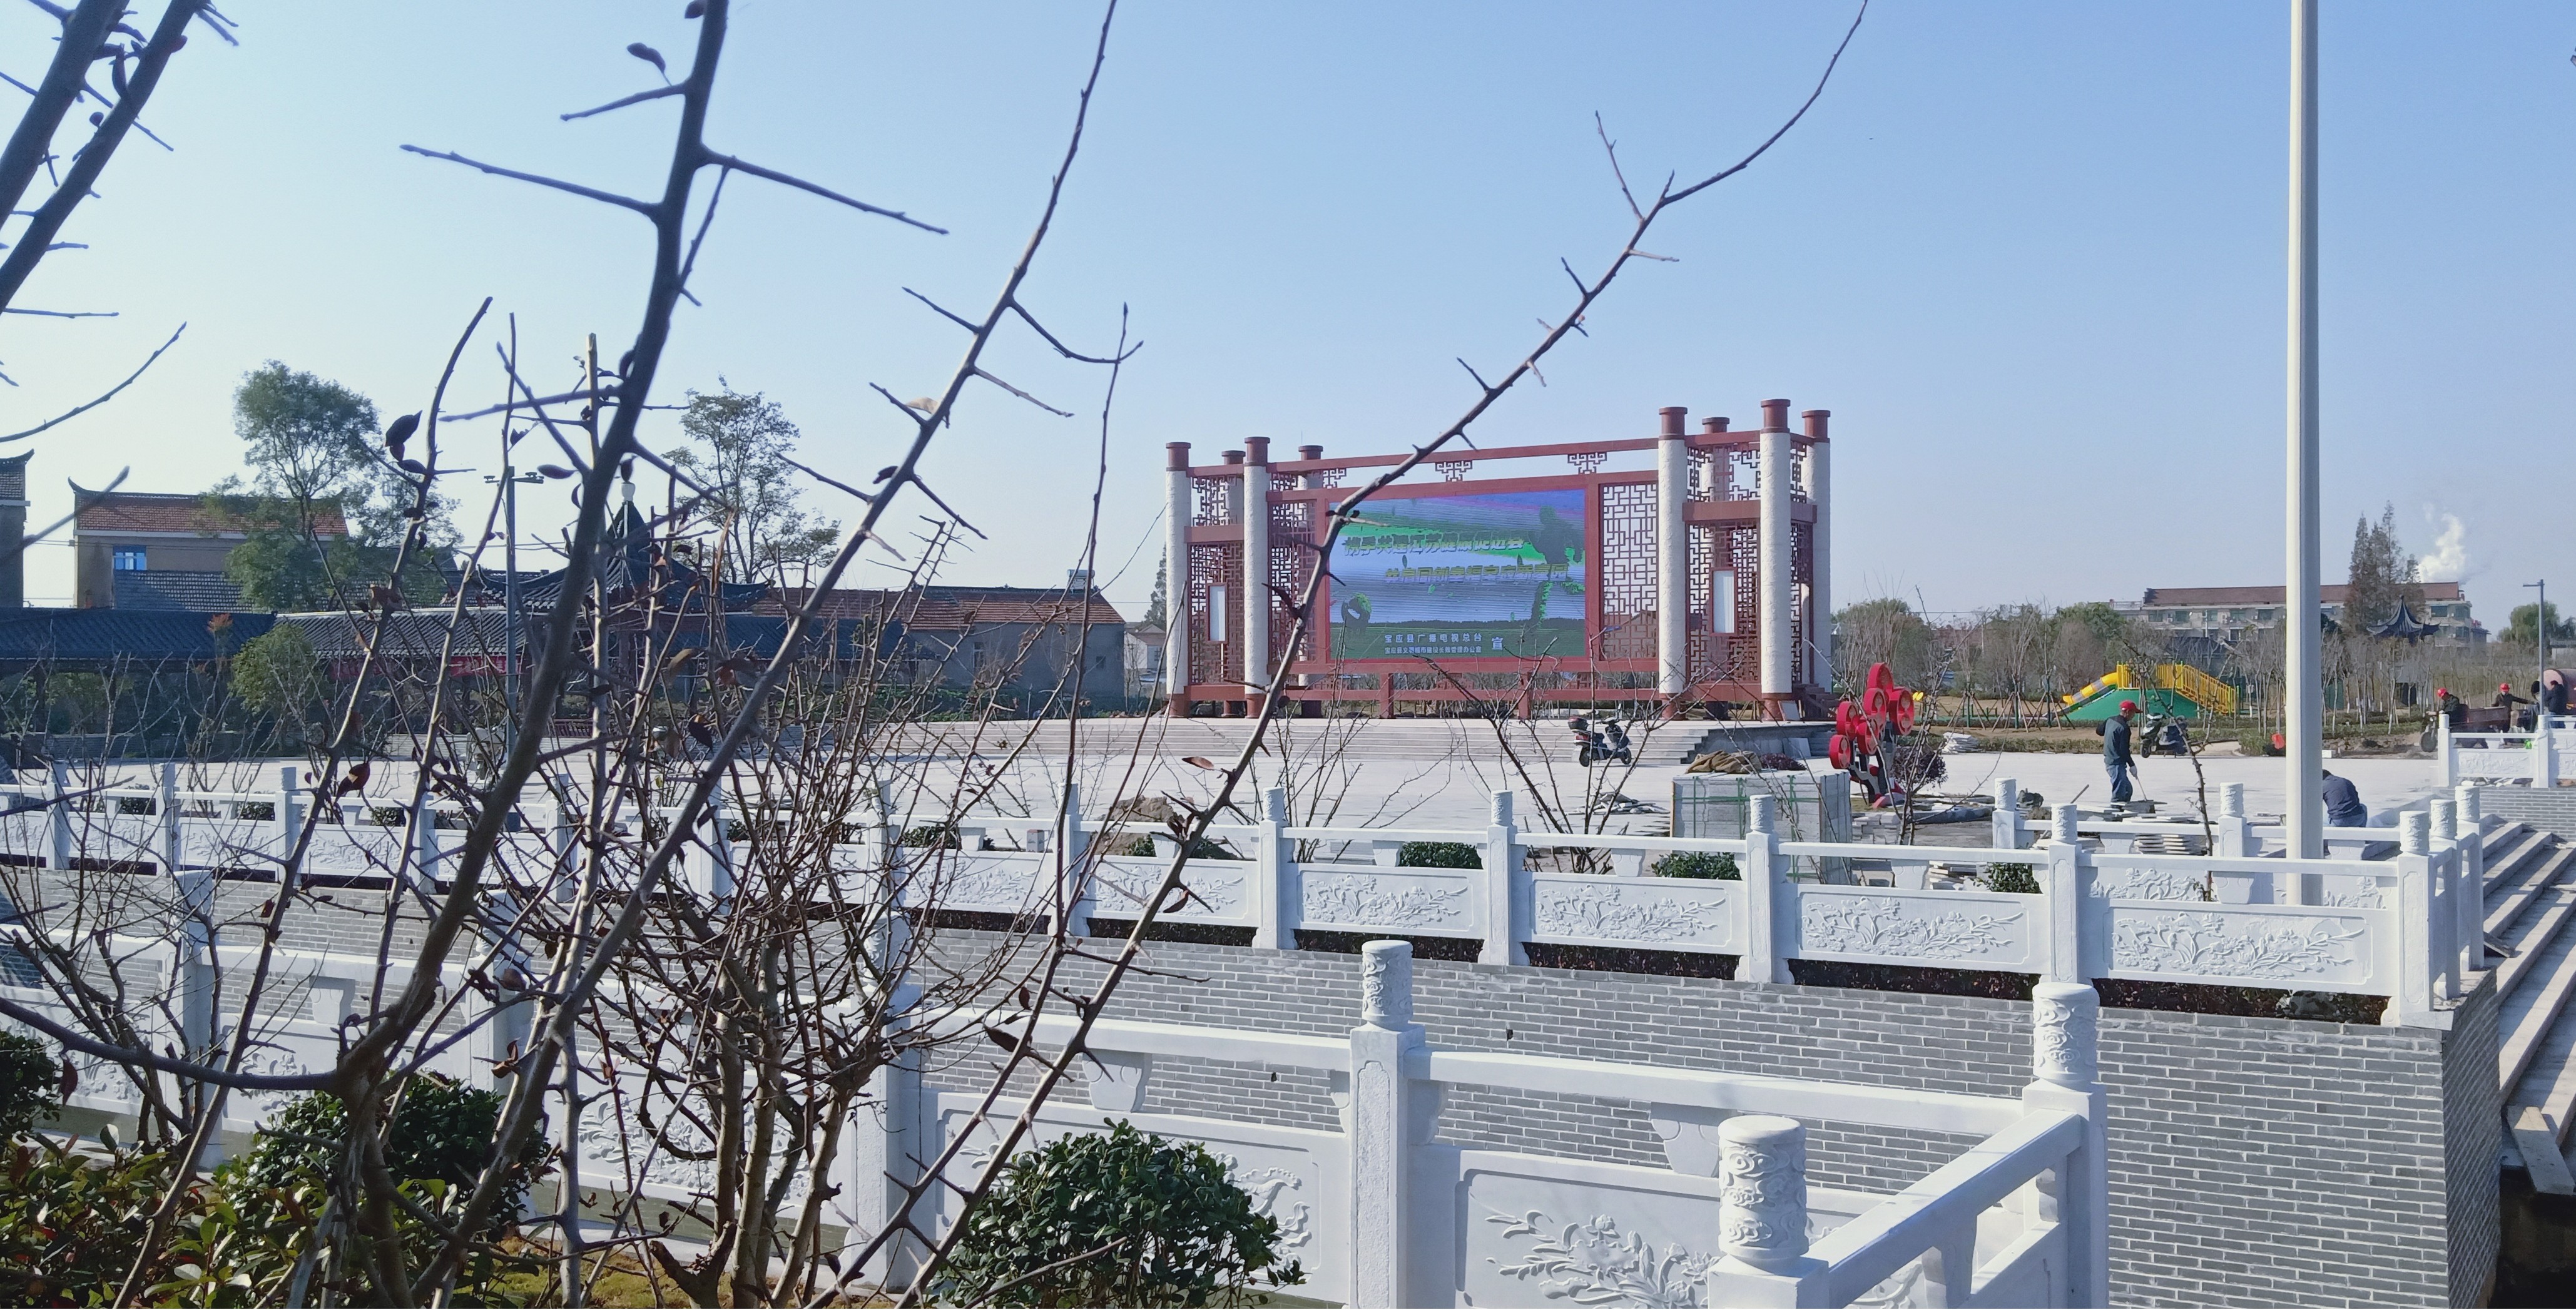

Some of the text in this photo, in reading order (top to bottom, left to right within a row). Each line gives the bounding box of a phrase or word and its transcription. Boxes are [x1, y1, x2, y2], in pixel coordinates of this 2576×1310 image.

[1385, 633, 1482, 643] 宝应县广播电视总台
[1492, 636, 1504, 650] 宣
